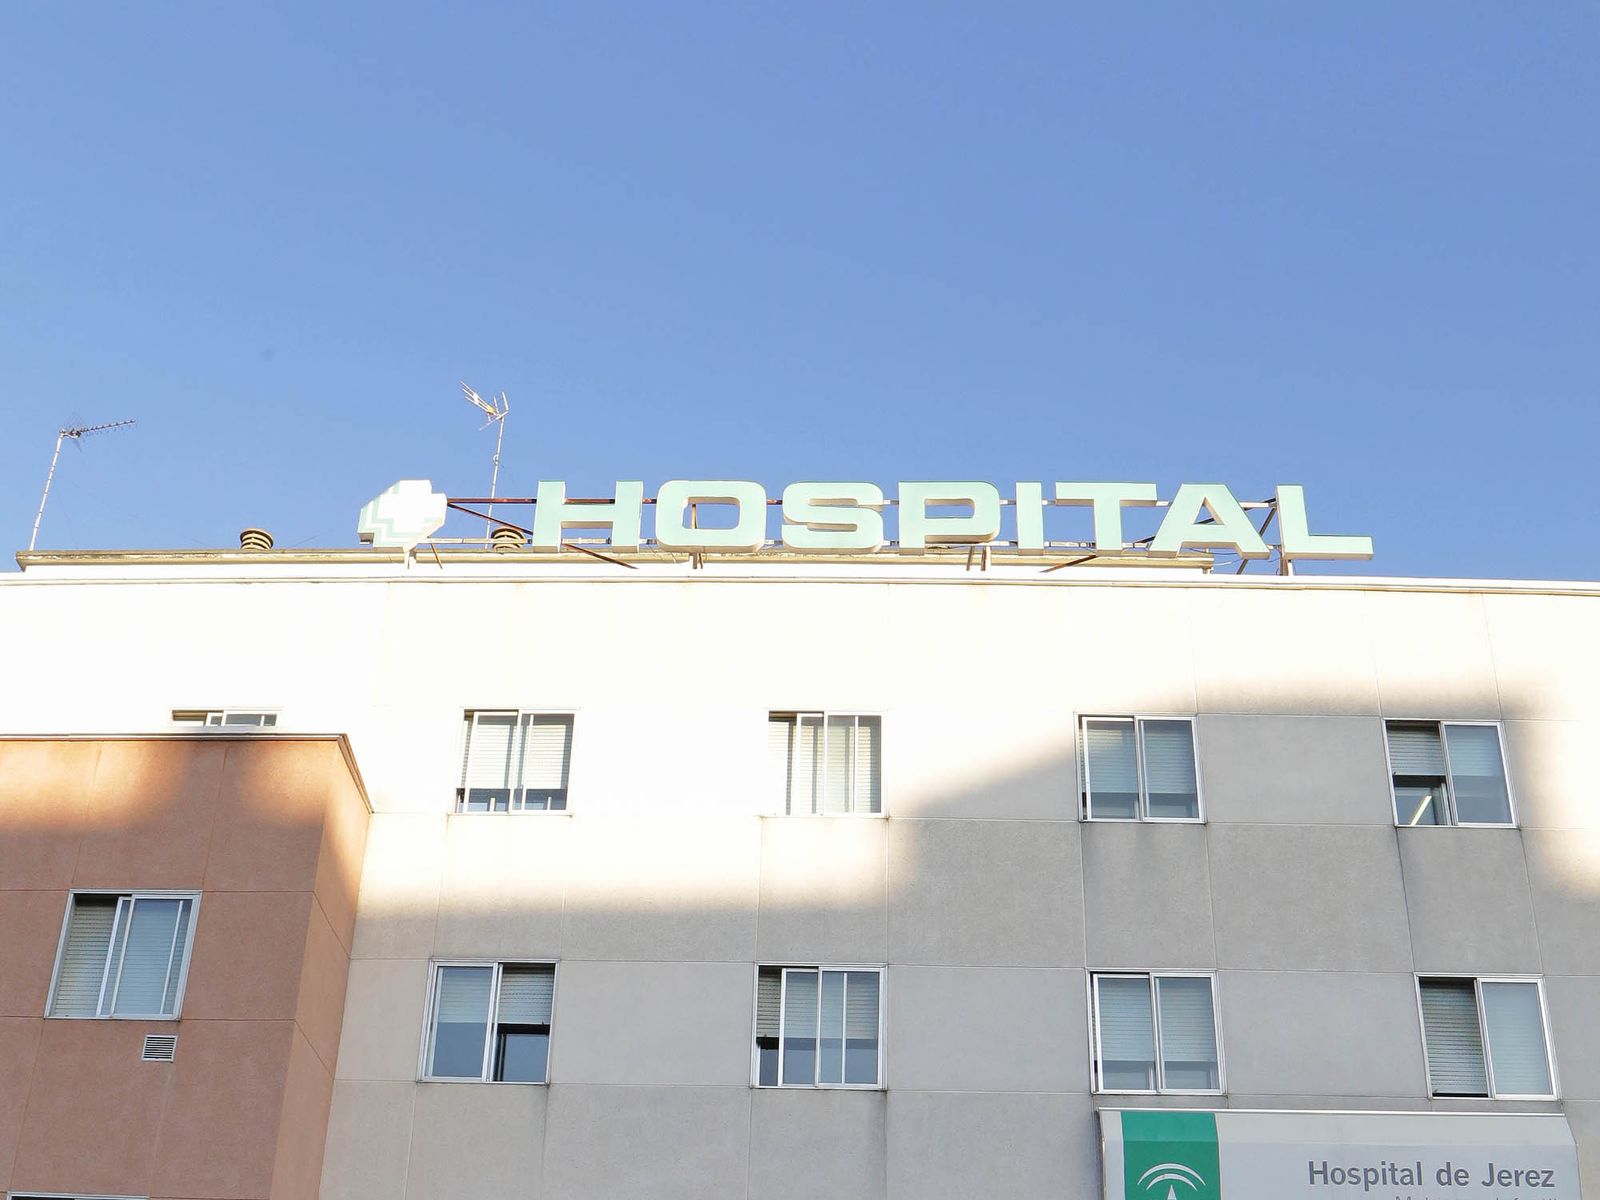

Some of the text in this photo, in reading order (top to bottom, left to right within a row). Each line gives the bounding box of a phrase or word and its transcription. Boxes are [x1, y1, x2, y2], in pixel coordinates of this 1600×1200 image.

[535, 480, 1374, 561] HOSPITAL
[1308, 1160, 1555, 1192] Hospital de Jerez
